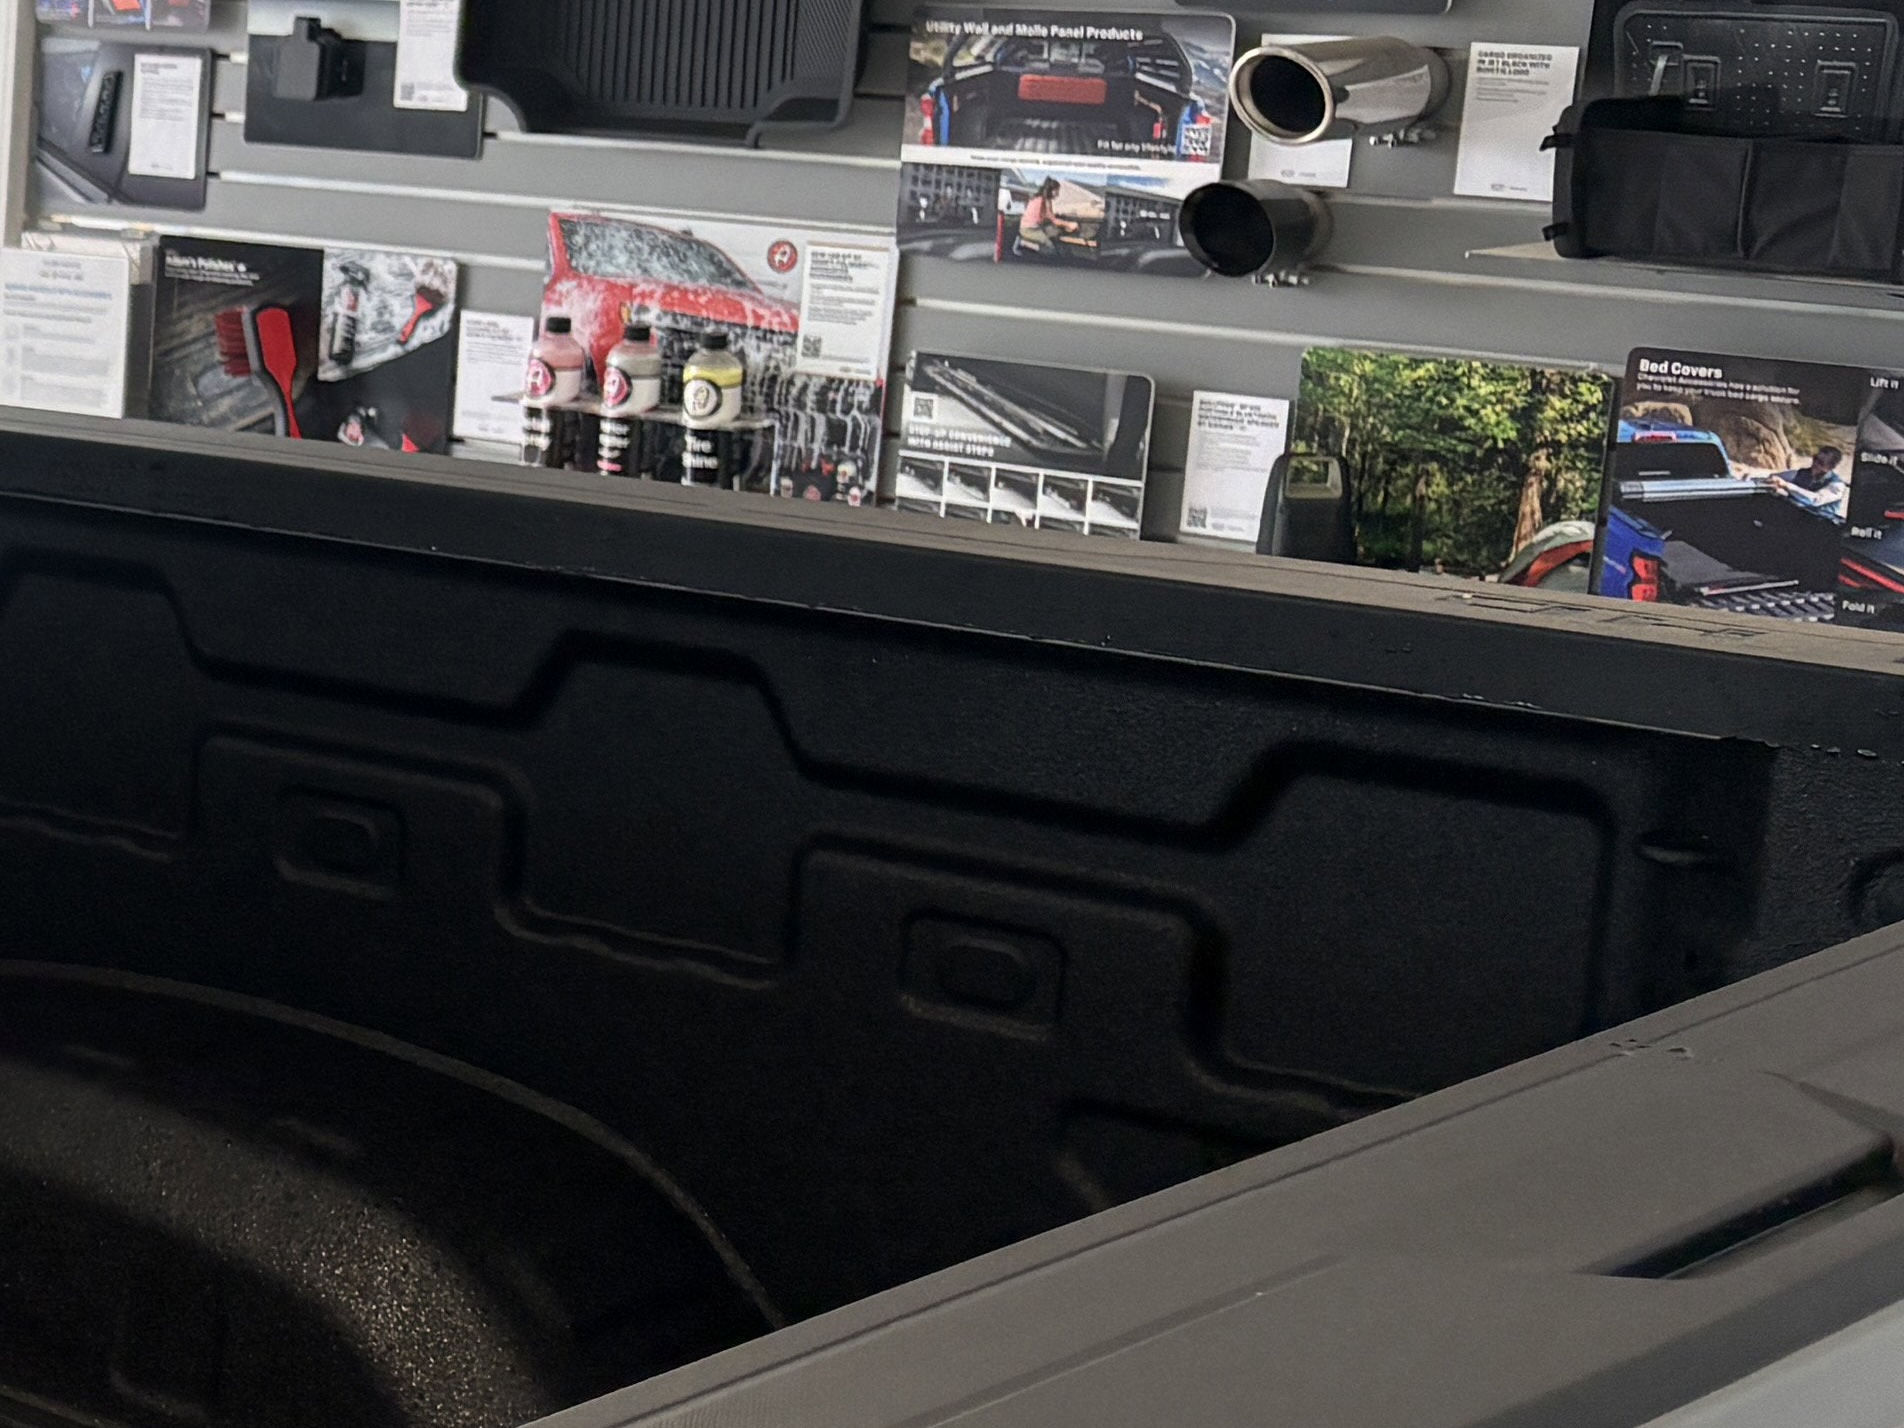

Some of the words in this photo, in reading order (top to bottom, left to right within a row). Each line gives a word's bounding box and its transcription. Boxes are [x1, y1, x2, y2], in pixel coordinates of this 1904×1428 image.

[926, 20, 961, 36] Utility
[964, 22, 990, 36] Wall
[992, 24, 1014, 37] and
[1015, 23, 1049, 39] Molle
[1050, 25, 1084, 40] Panel
[1086, 26, 1144, 42] Products
[1639, 358, 1669, 374] Bed
[1671, 361, 1723, 379] Covers
[1870, 376, 1889, 389] Lift
[1890, 379, 1900, 391] it
[1861, 451, 1888, 465] Slide
[1851, 526, 1872, 539] Roll
[1842, 599, 1866, 613] Fold
